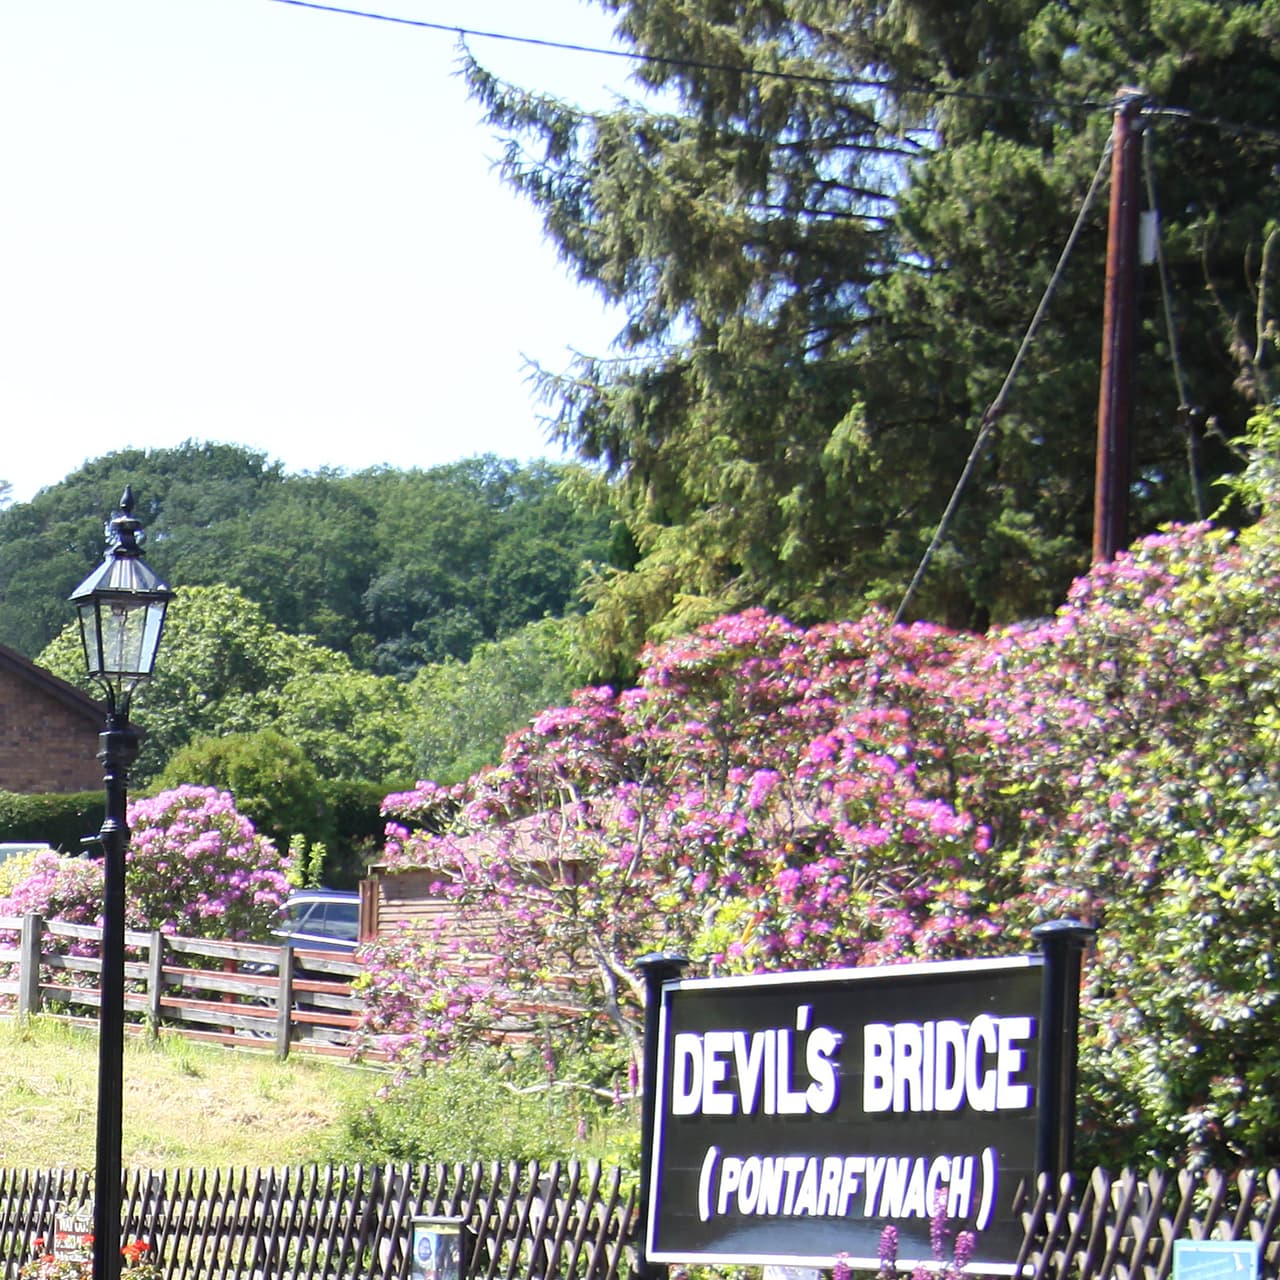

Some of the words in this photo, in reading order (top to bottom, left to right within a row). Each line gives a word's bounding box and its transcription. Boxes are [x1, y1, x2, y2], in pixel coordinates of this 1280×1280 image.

[673, 1006, 842, 1115] DEVIL'S
[863, 1014, 1035, 1114] BRIDGE
[698, 1146, 997, 1232] (PONTARFYNACH)
